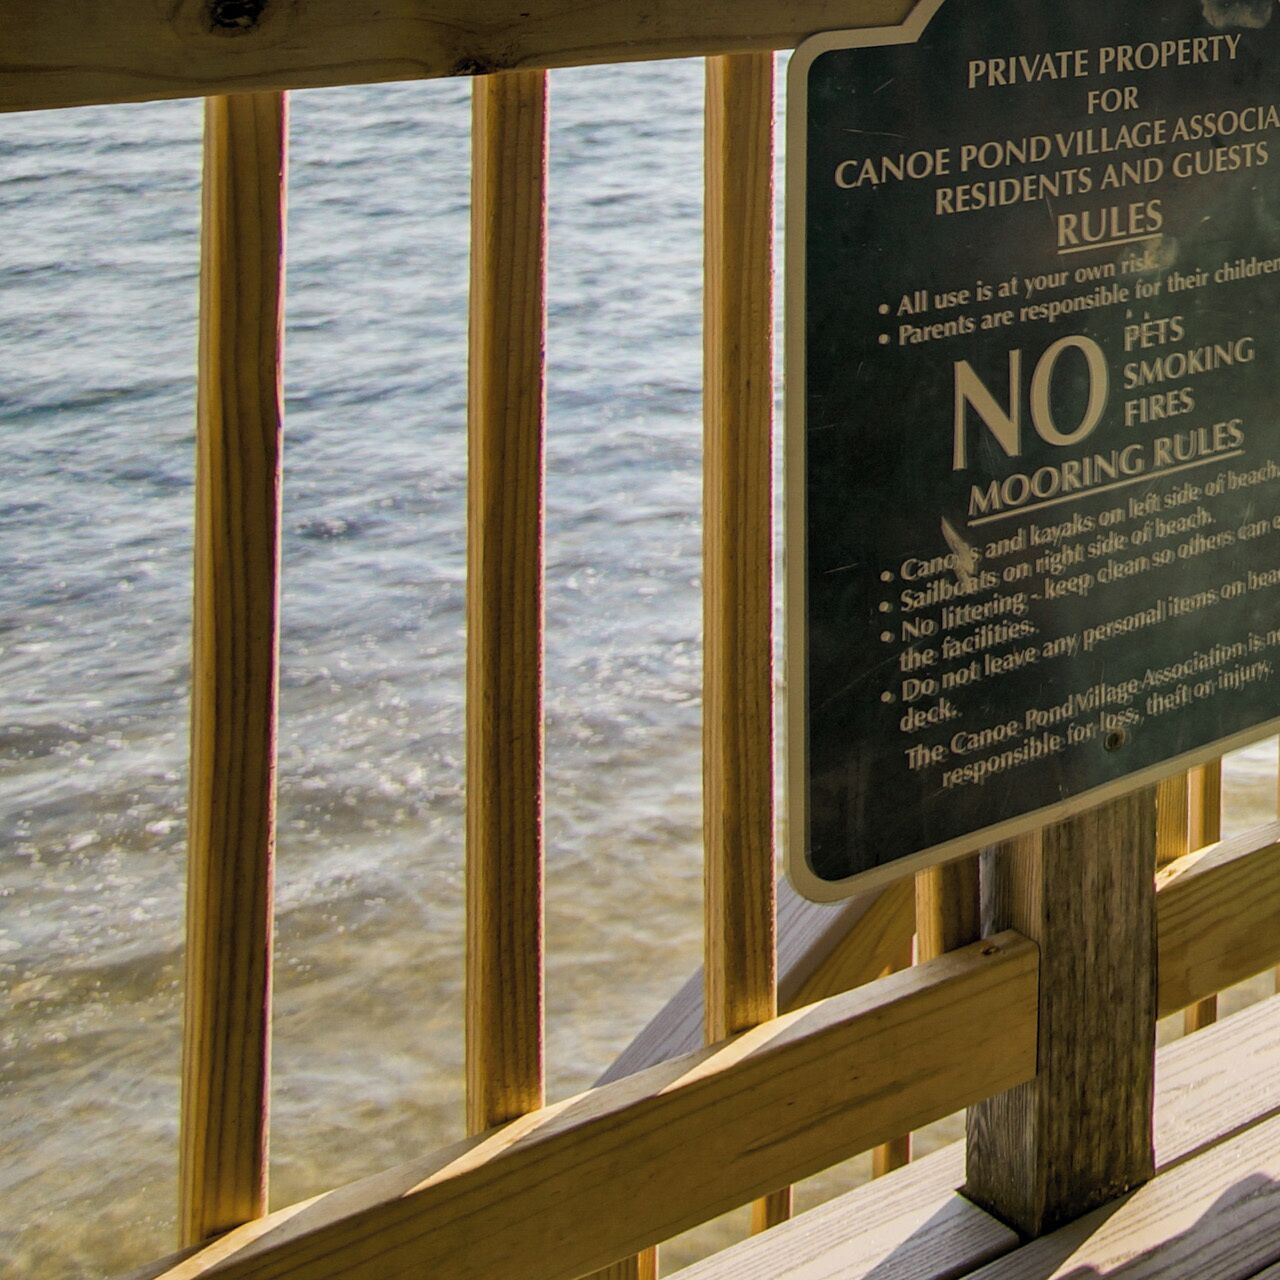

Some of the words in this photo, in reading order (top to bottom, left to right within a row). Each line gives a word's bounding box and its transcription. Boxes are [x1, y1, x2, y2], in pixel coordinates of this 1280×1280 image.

[968, 49, 1089, 89] PRIVATE
[1099, 34, 1241, 74] PROPERTY
[1087, 87, 1139, 114] FOR
[834, 148, 950, 190] CANOE
[960, 135, 1052, 172] POND
[1055, 120, 1167, 158] VILLAGE
[935, 167, 1093, 215] RESIDENTS
[1100, 158, 1164, 190] AND
[1172, 141, 1269, 178] GUESTS
[1057, 200, 1163, 247] RULES
[897, 290, 929, 315] All
[934, 289, 970, 310] use
[975, 281, 993, 301] is
[998, 273, 1019, 297] at
[1024, 271, 1069, 299] your
[1074, 262, 1116, 283] own
[899, 316, 975, 346] Parents
[980, 309, 1015, 330] are
[1019, 283, 1130, 322] responsible
[1135, 277, 1161, 300] for
[1167, 268, 1210, 293] their
[1123, 315, 1185, 352] PETS
[1123, 337, 1255, 390] SMOKING
[952, 335, 1109, 471] NO
[1124, 387, 1196, 427] FIRES
[967, 444, 1146, 516] MOORING
[1153, 418, 1245, 467] RULES
[900, 546, 983, 581] Canos
[984, 527, 1025, 558] and
[1029, 510, 1097, 549] kayaks
[1099, 508, 1126, 527] on
[1128, 493, 1162, 520] left
[1163, 481, 1202, 509] side
[1204, 473, 1225, 497] of
[901, 568, 998, 612] Sailboats
[1002, 562, 1032, 583] on
[1035, 542, 1085, 577] right
[1087, 530, 1128, 559] side
[1130, 521, 1153, 547] of
[1154, 505, 1217, 539] beach.
[901, 617, 937, 642] No
[941, 591, 1028, 631] littering
[1044, 571, 1095, 605] keep
[1097, 557, 1151, 583] clean
[1151, 546, 1175, 568] so
[1177, 530, 1237, 560] others
[1237, 519, 1271, 542] can
[900, 646, 939, 673] the
[942, 619, 1039, 659] facilities.
[902, 677, 939, 703] Do
[942, 660, 981, 690] not
[984, 644, 1040, 677] leave
[1042, 633, 1080, 659] any
[1083, 599, 1165, 652] personal
[1167, 588, 1219, 619] items
[1220, 580, 1247, 600] on
[900, 696, 962, 734] deck.
[905, 742, 949, 770] The
[951, 718, 1022, 756] Canoe
[1025, 692, 1075, 732] Pond
[1074, 674, 1142, 712] Village
[1142, 642, 1247, 692] Association
[1247, 632, 1266, 652] is
[942, 729, 1065, 790] responsible
[1066, 721, 1097, 746] for
[1100, 706, 1145, 733] loss,
[1146, 683, 1193, 717] theft
[1193, 679, 1217, 700] or
[1218, 660, 1274, 692] injury.
